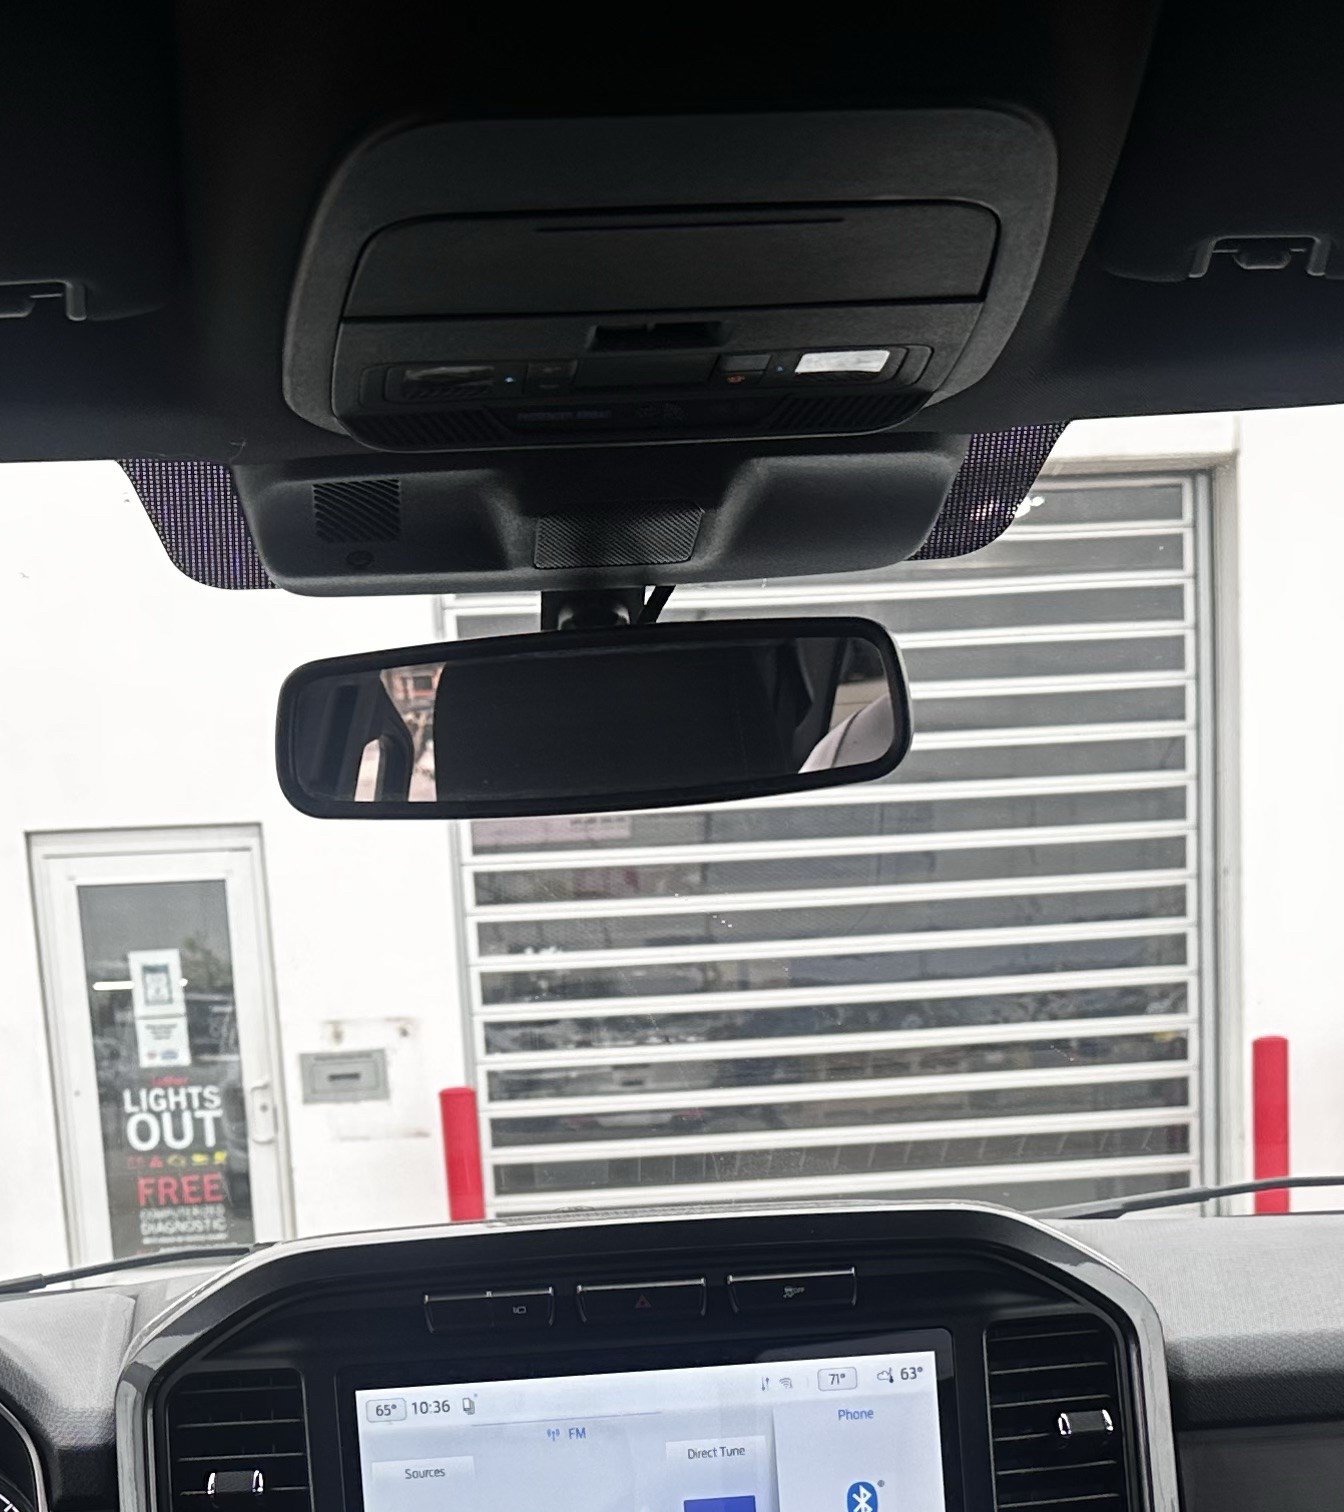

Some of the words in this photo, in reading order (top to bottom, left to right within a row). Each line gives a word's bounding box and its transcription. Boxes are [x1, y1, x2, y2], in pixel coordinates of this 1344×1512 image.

[122, 1085, 223, 1113] LIGHTS
[126, 1108, 224, 1151] OUT
[137, 1172, 224, 1206] FREE
[411, 1399, 451, 1415] 10:36
[837, 1408, 874, 1421] Phone
[568, 1427, 587, 1439] FM
[687, 1447, 717, 1460] Direct
[720, 1446, 746, 1458] Tune
[404, 1467, 446, 1480] Sources
